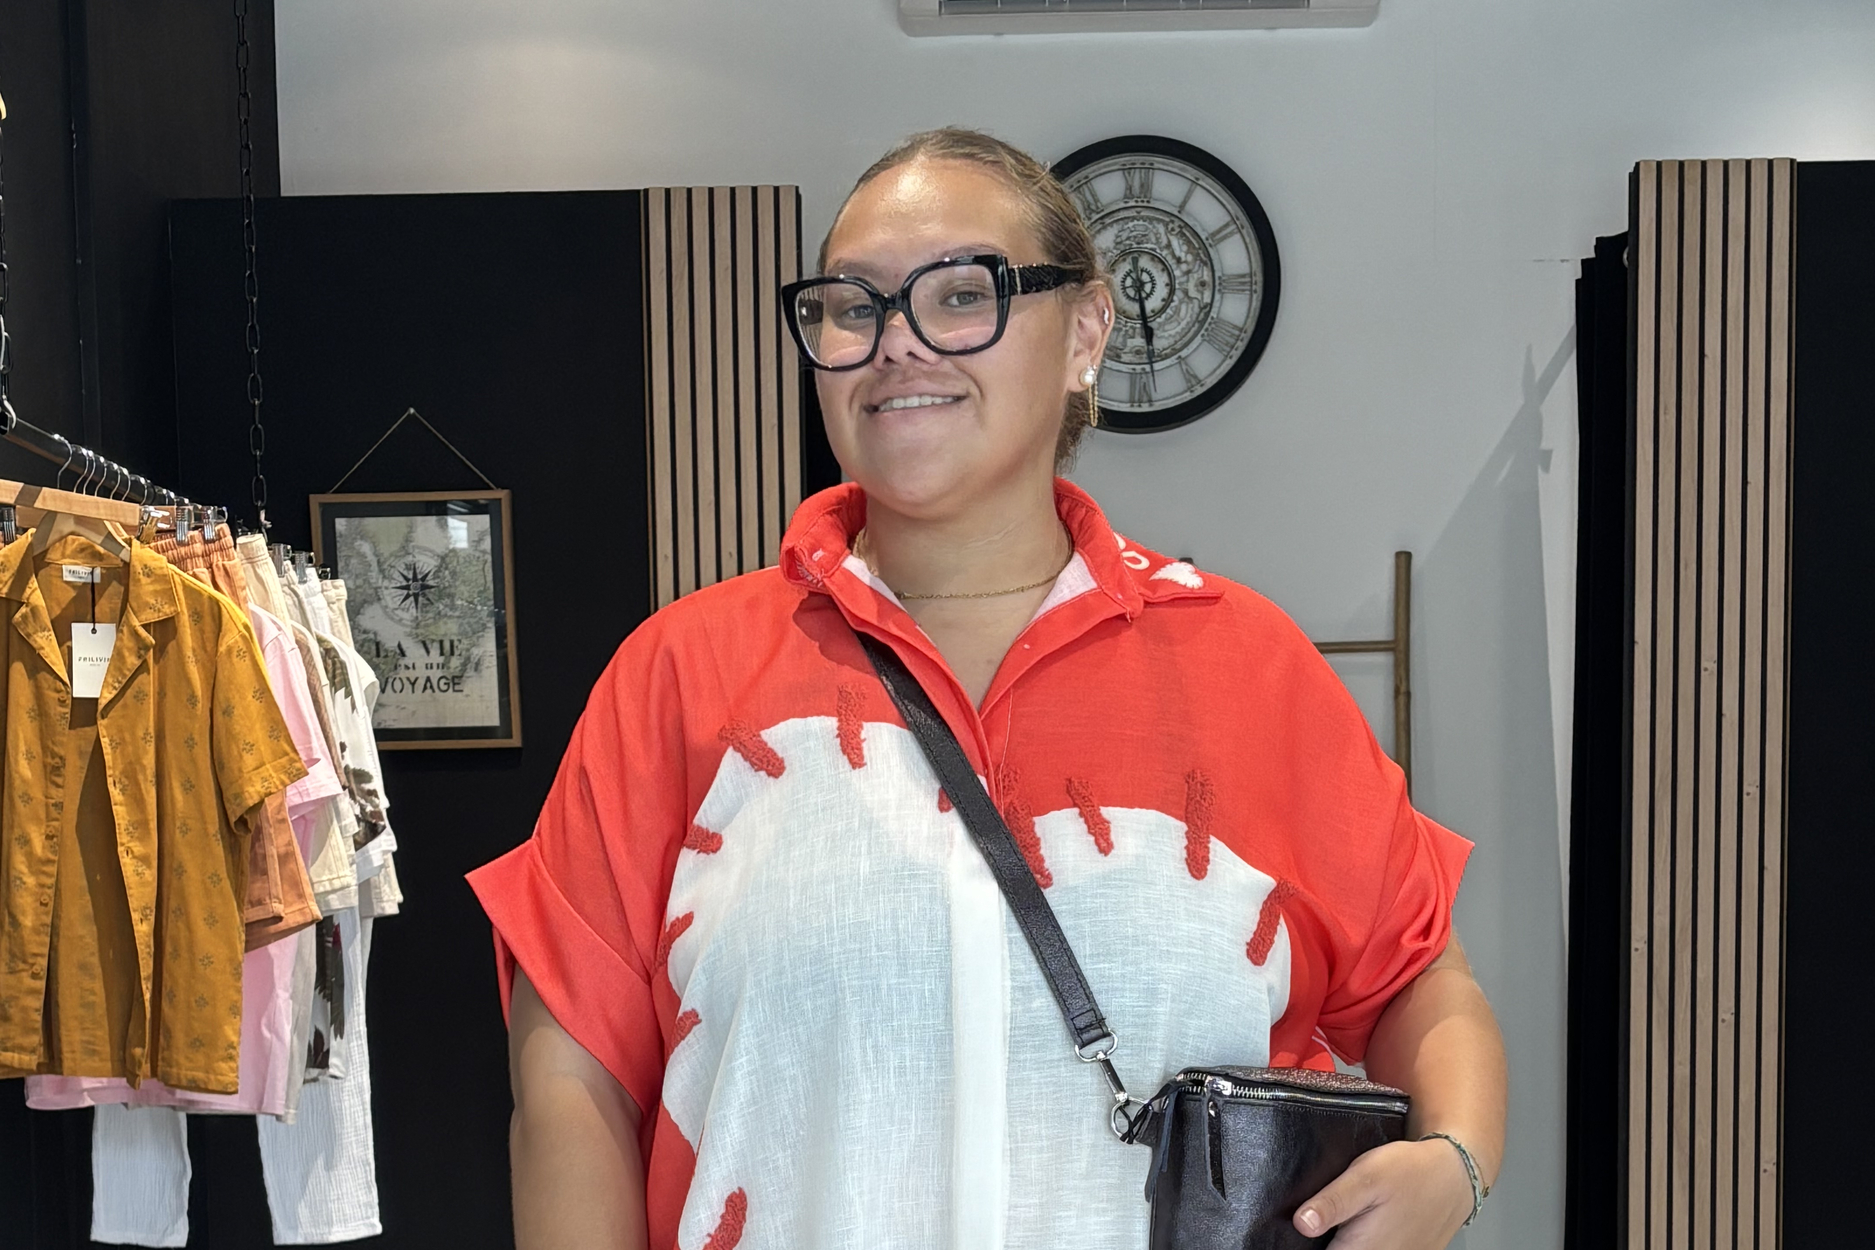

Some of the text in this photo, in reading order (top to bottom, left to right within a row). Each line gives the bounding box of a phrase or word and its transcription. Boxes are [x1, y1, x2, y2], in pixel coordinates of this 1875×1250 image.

[375, 638, 462, 658] LA VIE
[394, 661, 446, 671] est un
[379, 675, 464, 695] VOYAGE
